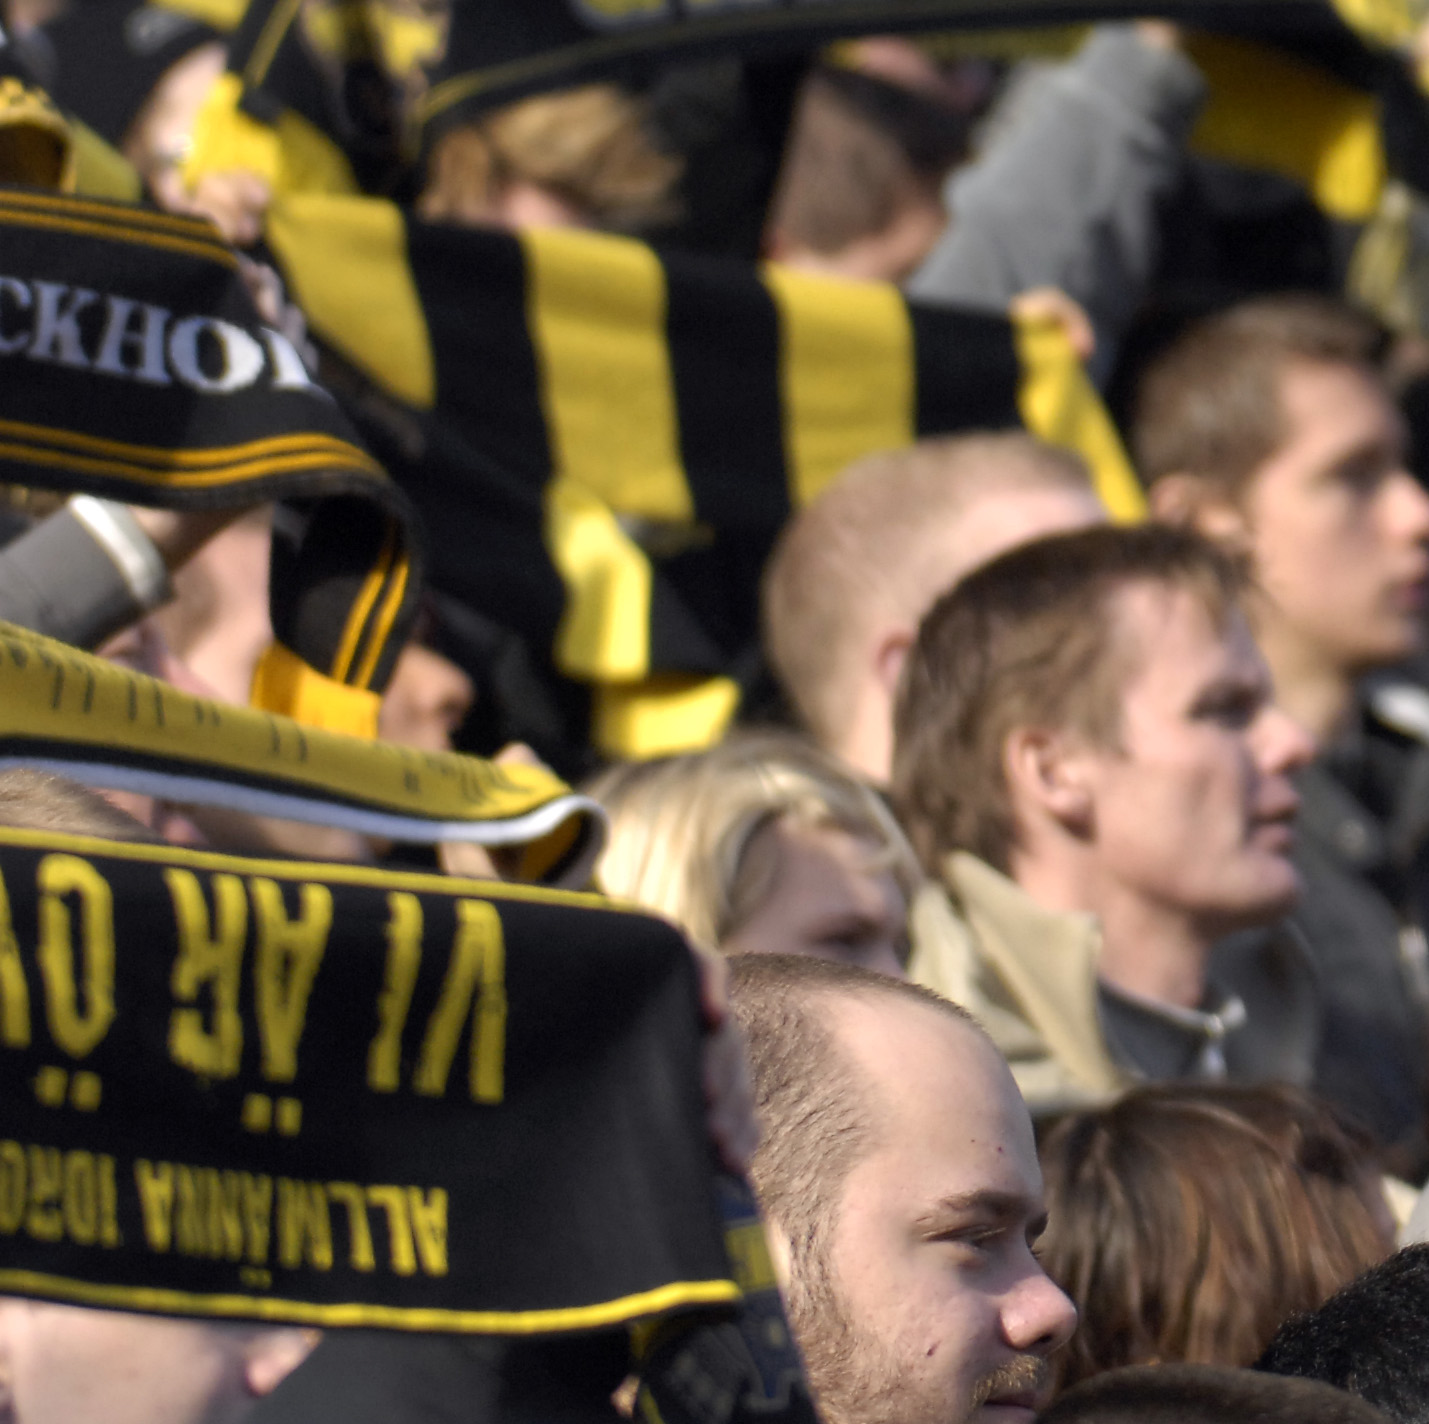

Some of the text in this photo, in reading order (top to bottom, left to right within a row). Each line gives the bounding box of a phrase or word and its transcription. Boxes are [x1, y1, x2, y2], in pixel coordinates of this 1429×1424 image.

[164, 867, 333, 1136] ÄR
[369, 891, 507, 1104] VI
[134, 1157, 449, 1289] ALLMÄNNA
